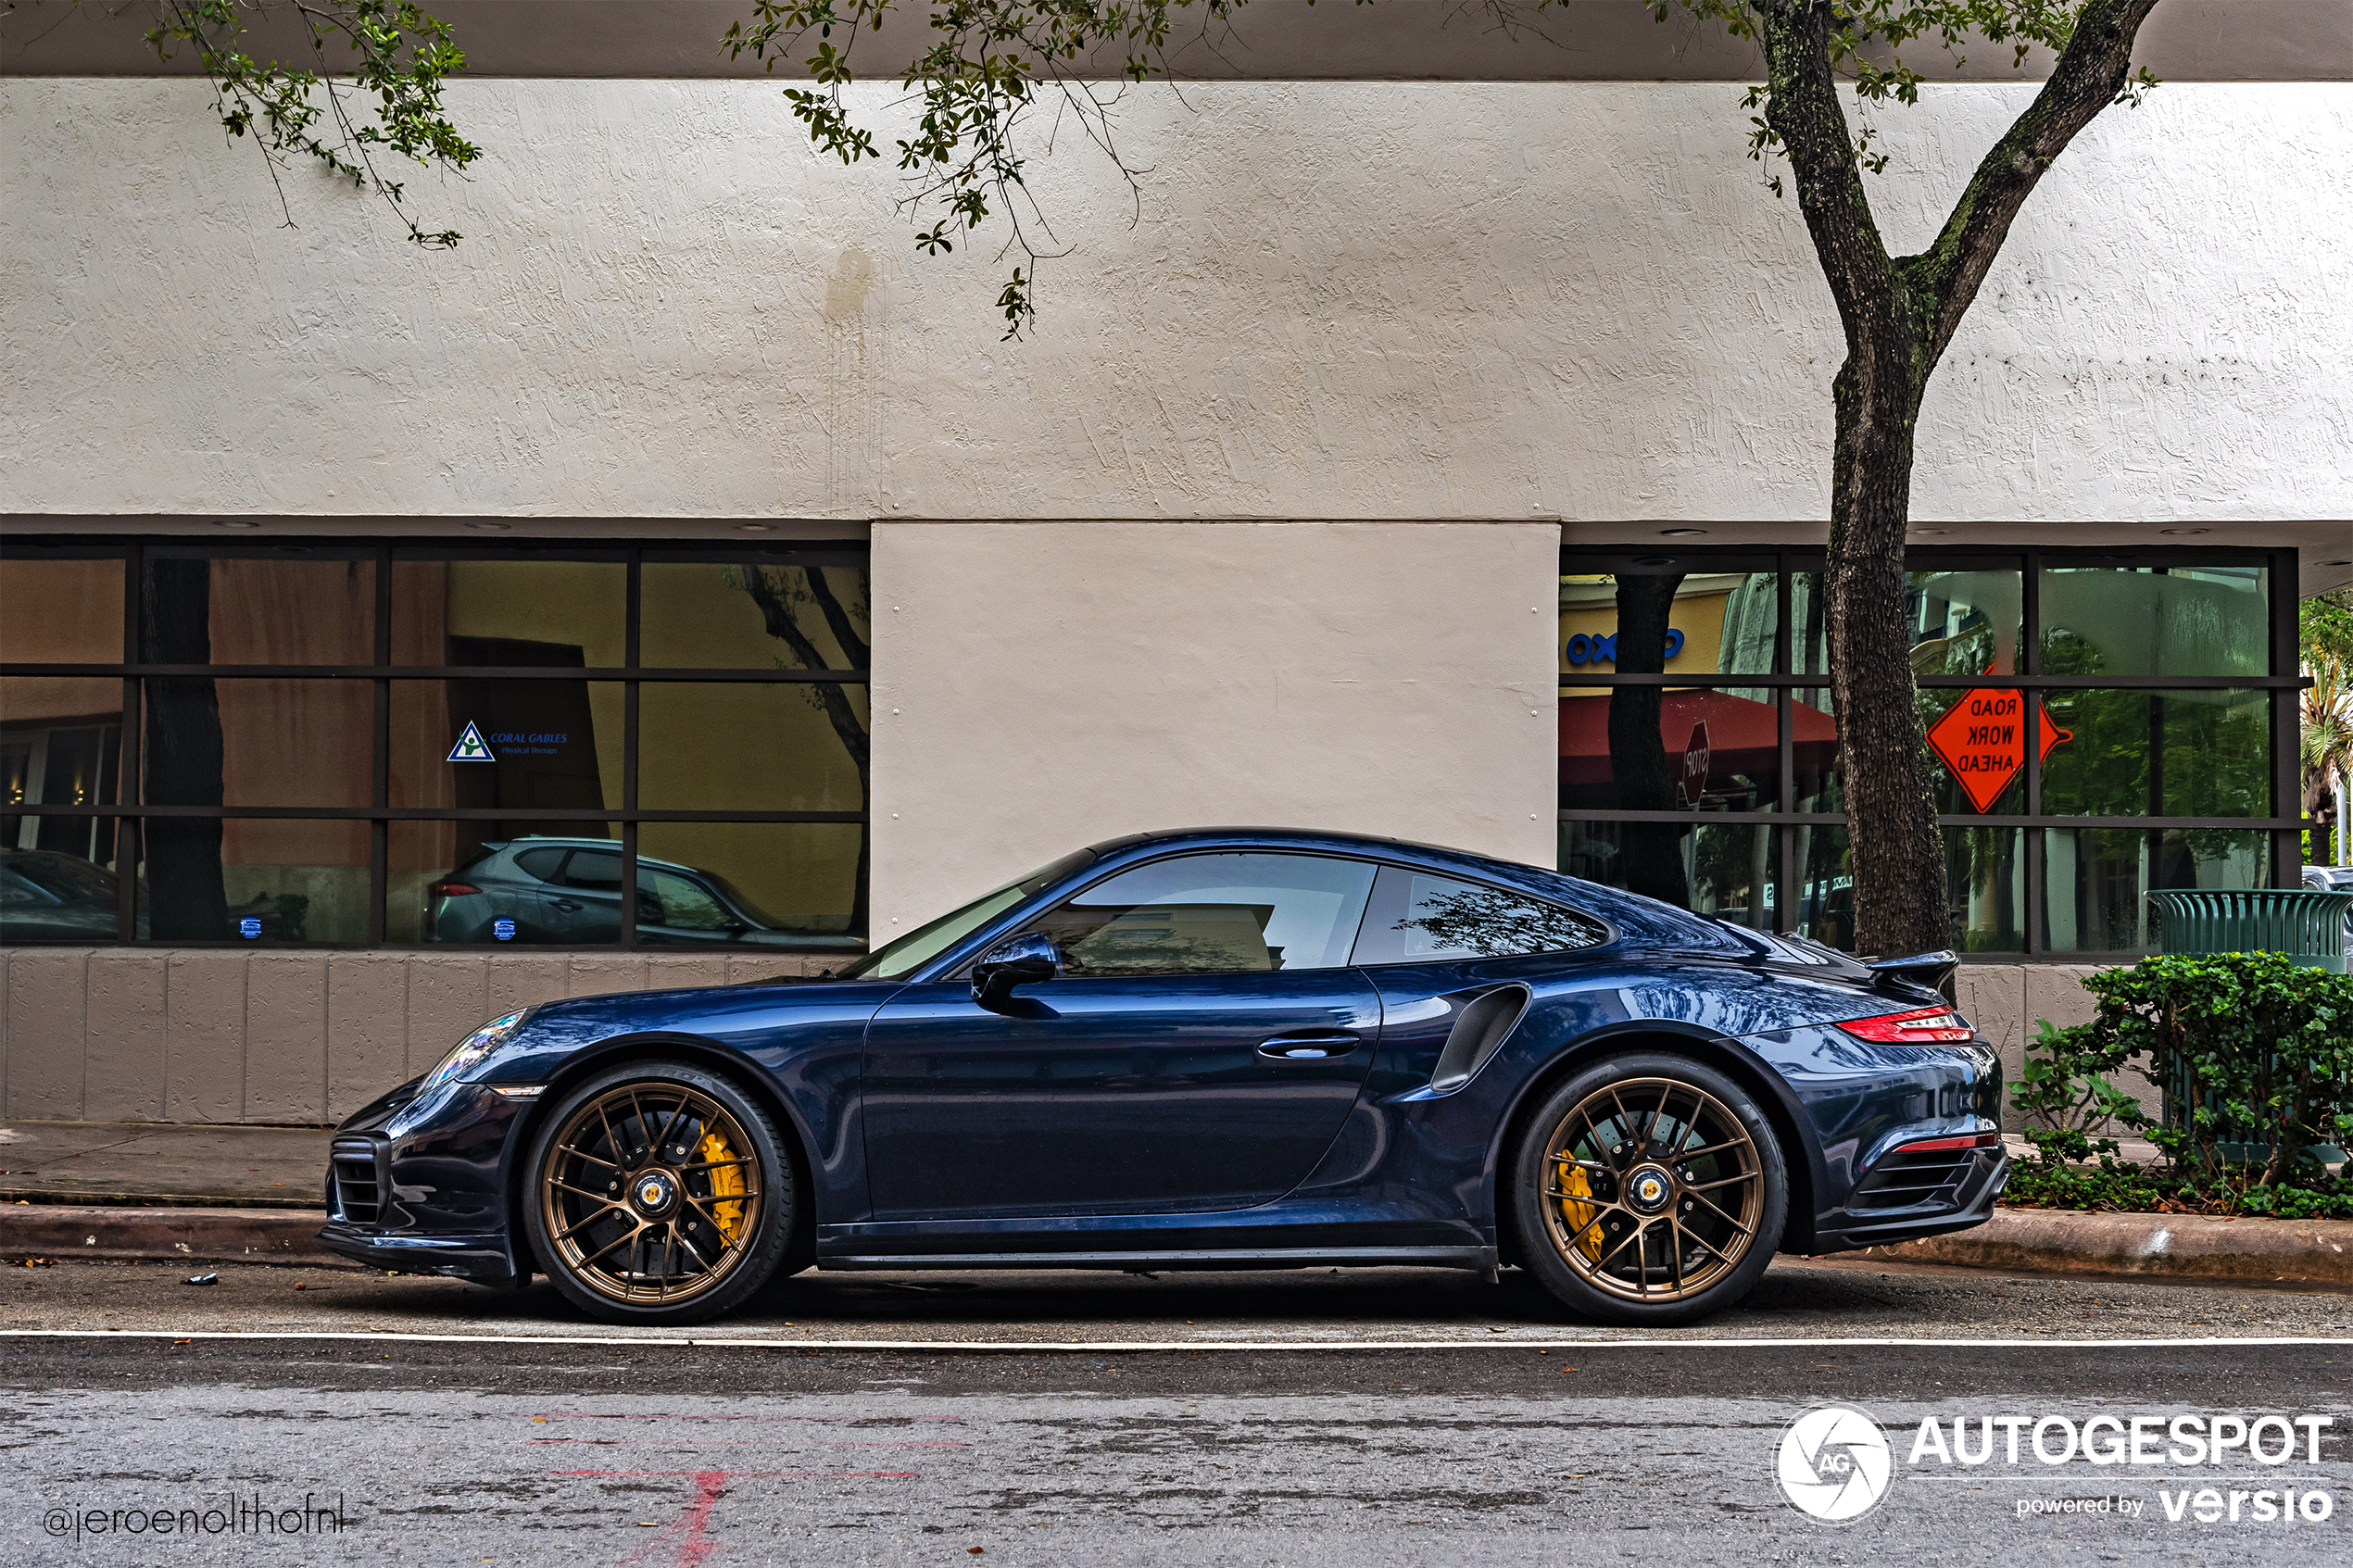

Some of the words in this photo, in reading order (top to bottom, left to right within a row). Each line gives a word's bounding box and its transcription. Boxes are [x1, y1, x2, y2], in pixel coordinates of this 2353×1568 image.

[490, 734, 524, 743] CORAL
[529, 734, 567, 743] GABLES
[501, 746, 529, 755] Physical
[531, 746, 558, 755] Therapy
